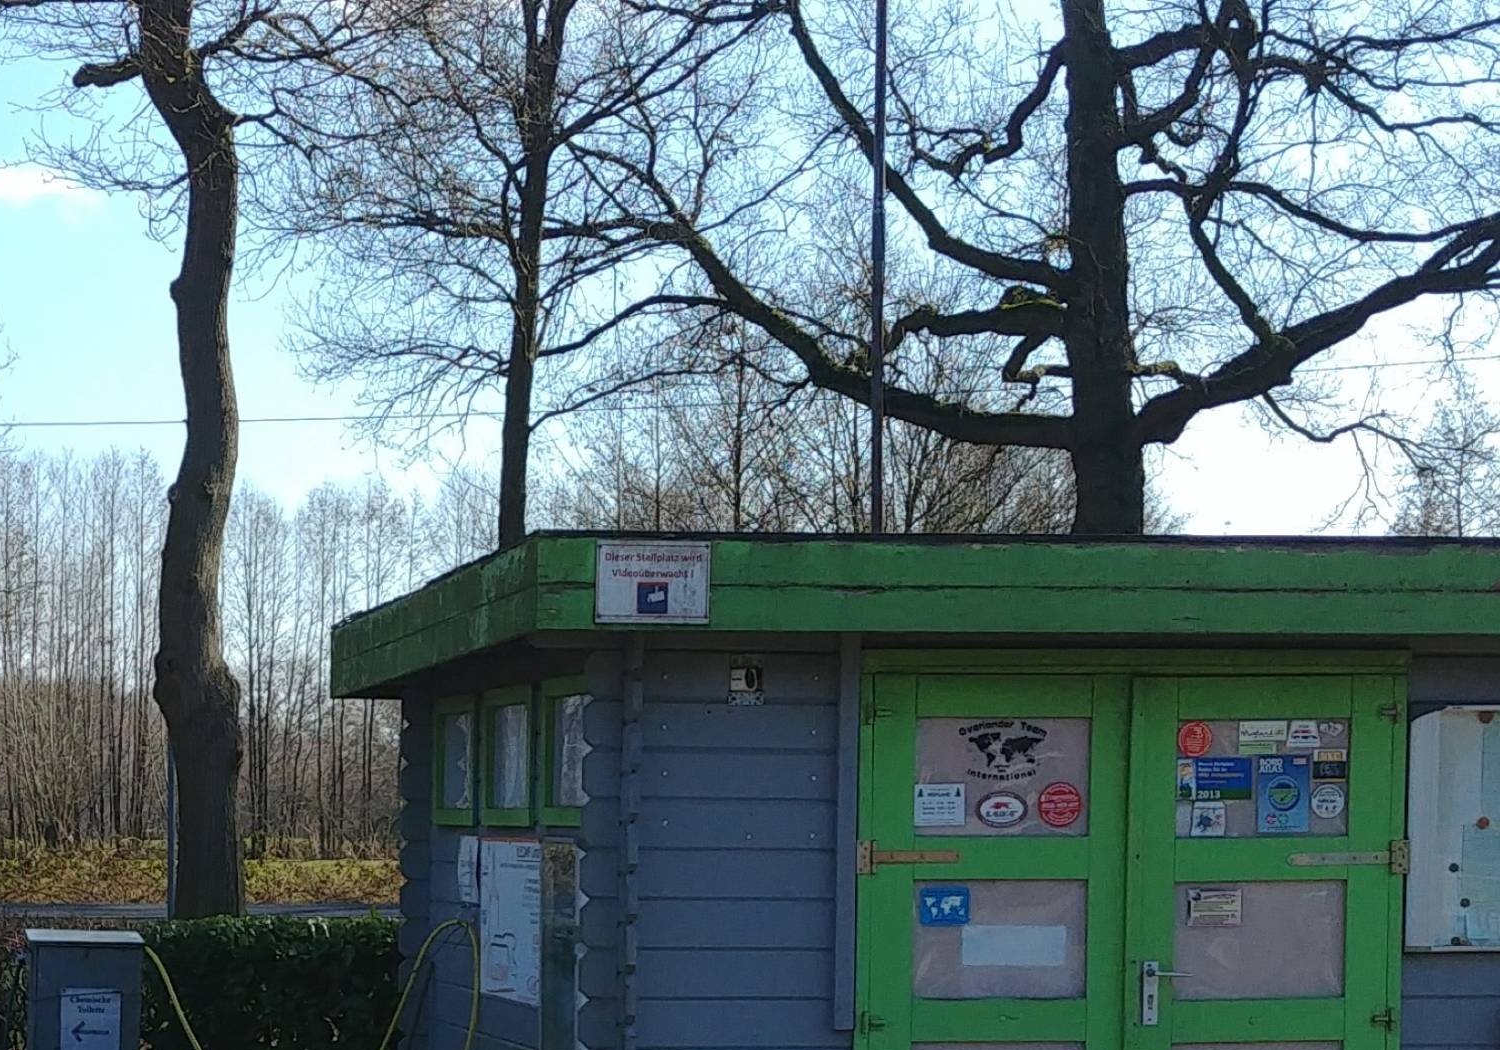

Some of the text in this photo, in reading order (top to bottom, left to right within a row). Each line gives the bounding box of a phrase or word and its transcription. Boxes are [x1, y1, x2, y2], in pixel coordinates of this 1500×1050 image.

[604, 552, 703, 563] Dieser Stellplatz wird
[612, 568, 688, 578] Videoüberwacht
[958, 720, 1048, 738] Overlander Team
[966, 768, 1037, 782] International
[1196, 790, 1221, 799] 2013
